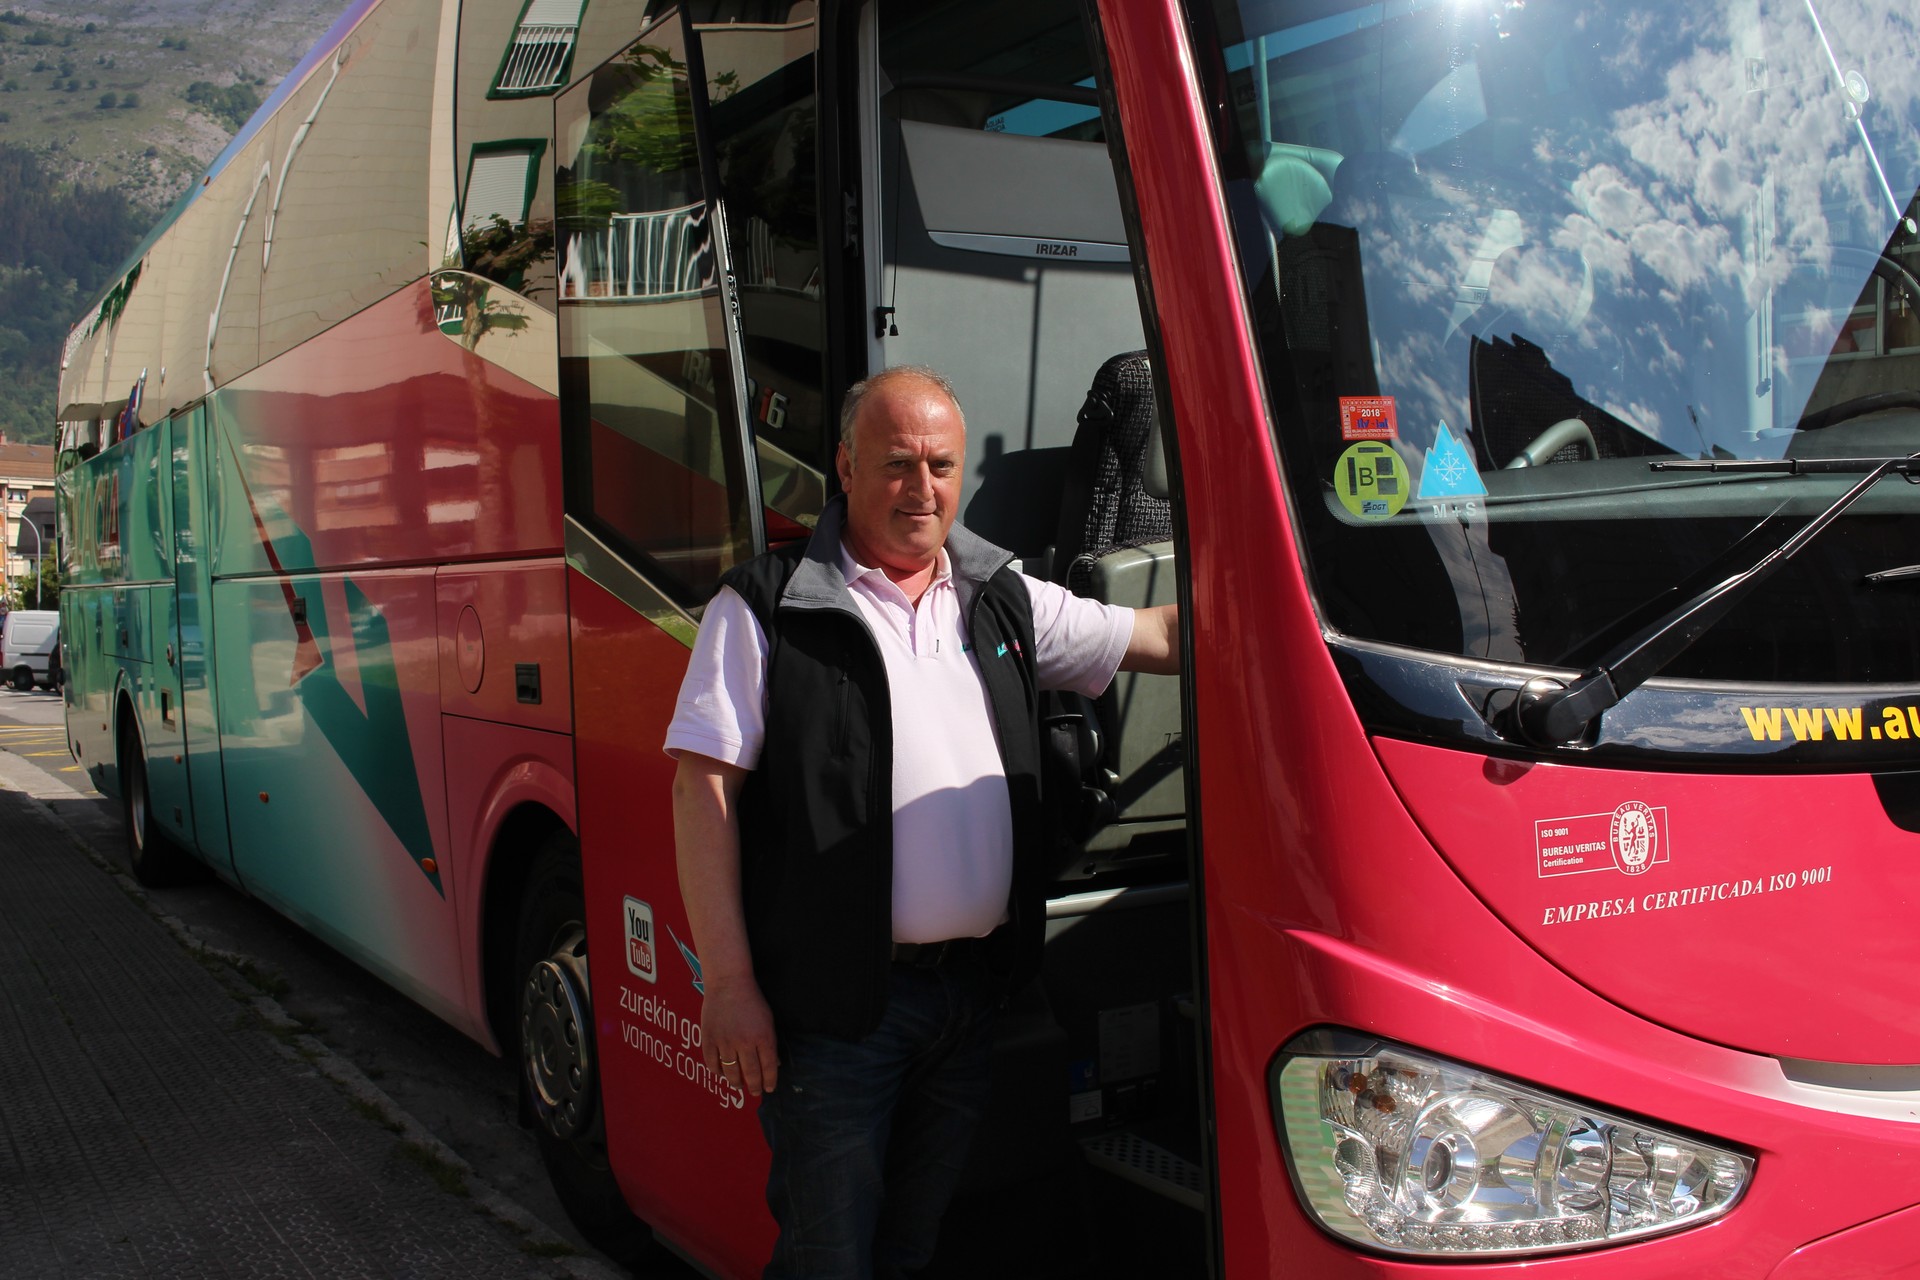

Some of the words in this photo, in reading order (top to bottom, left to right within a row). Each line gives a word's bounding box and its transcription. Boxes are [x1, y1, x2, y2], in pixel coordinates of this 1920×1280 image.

[1036, 243, 1078, 257] IRIZAR
[1361, 408, 1381, 417] 2018
[1358, 467, 1374, 487] B
[1372, 503, 1387, 511] DGT
[1612, 803, 1631, 843] BUREAU
[1633, 803, 1656, 839] VERITAS
[1541, 828, 1553, 838] ISO
[1554, 827, 1569, 837] 9001
[1542, 845, 1574, 857] BUREAU
[1574, 841, 1606, 854] VERITAS
[1543, 856, 1584, 868] Certification
[1626, 863, 1647, 873] 1828
[1542, 898, 1636, 926] EMPRESA
[1642, 876, 1764, 911] CERTIFICADA
[1768, 872, 1797, 892] ISO
[1801, 865, 1833, 886] 9001
[628, 907, 650, 943] You
[631, 941, 652, 970] Tube
[619, 985, 677, 1036] zurekin
[680, 1018, 702, 1049] go
[621, 1020, 673, 1069] vamos
